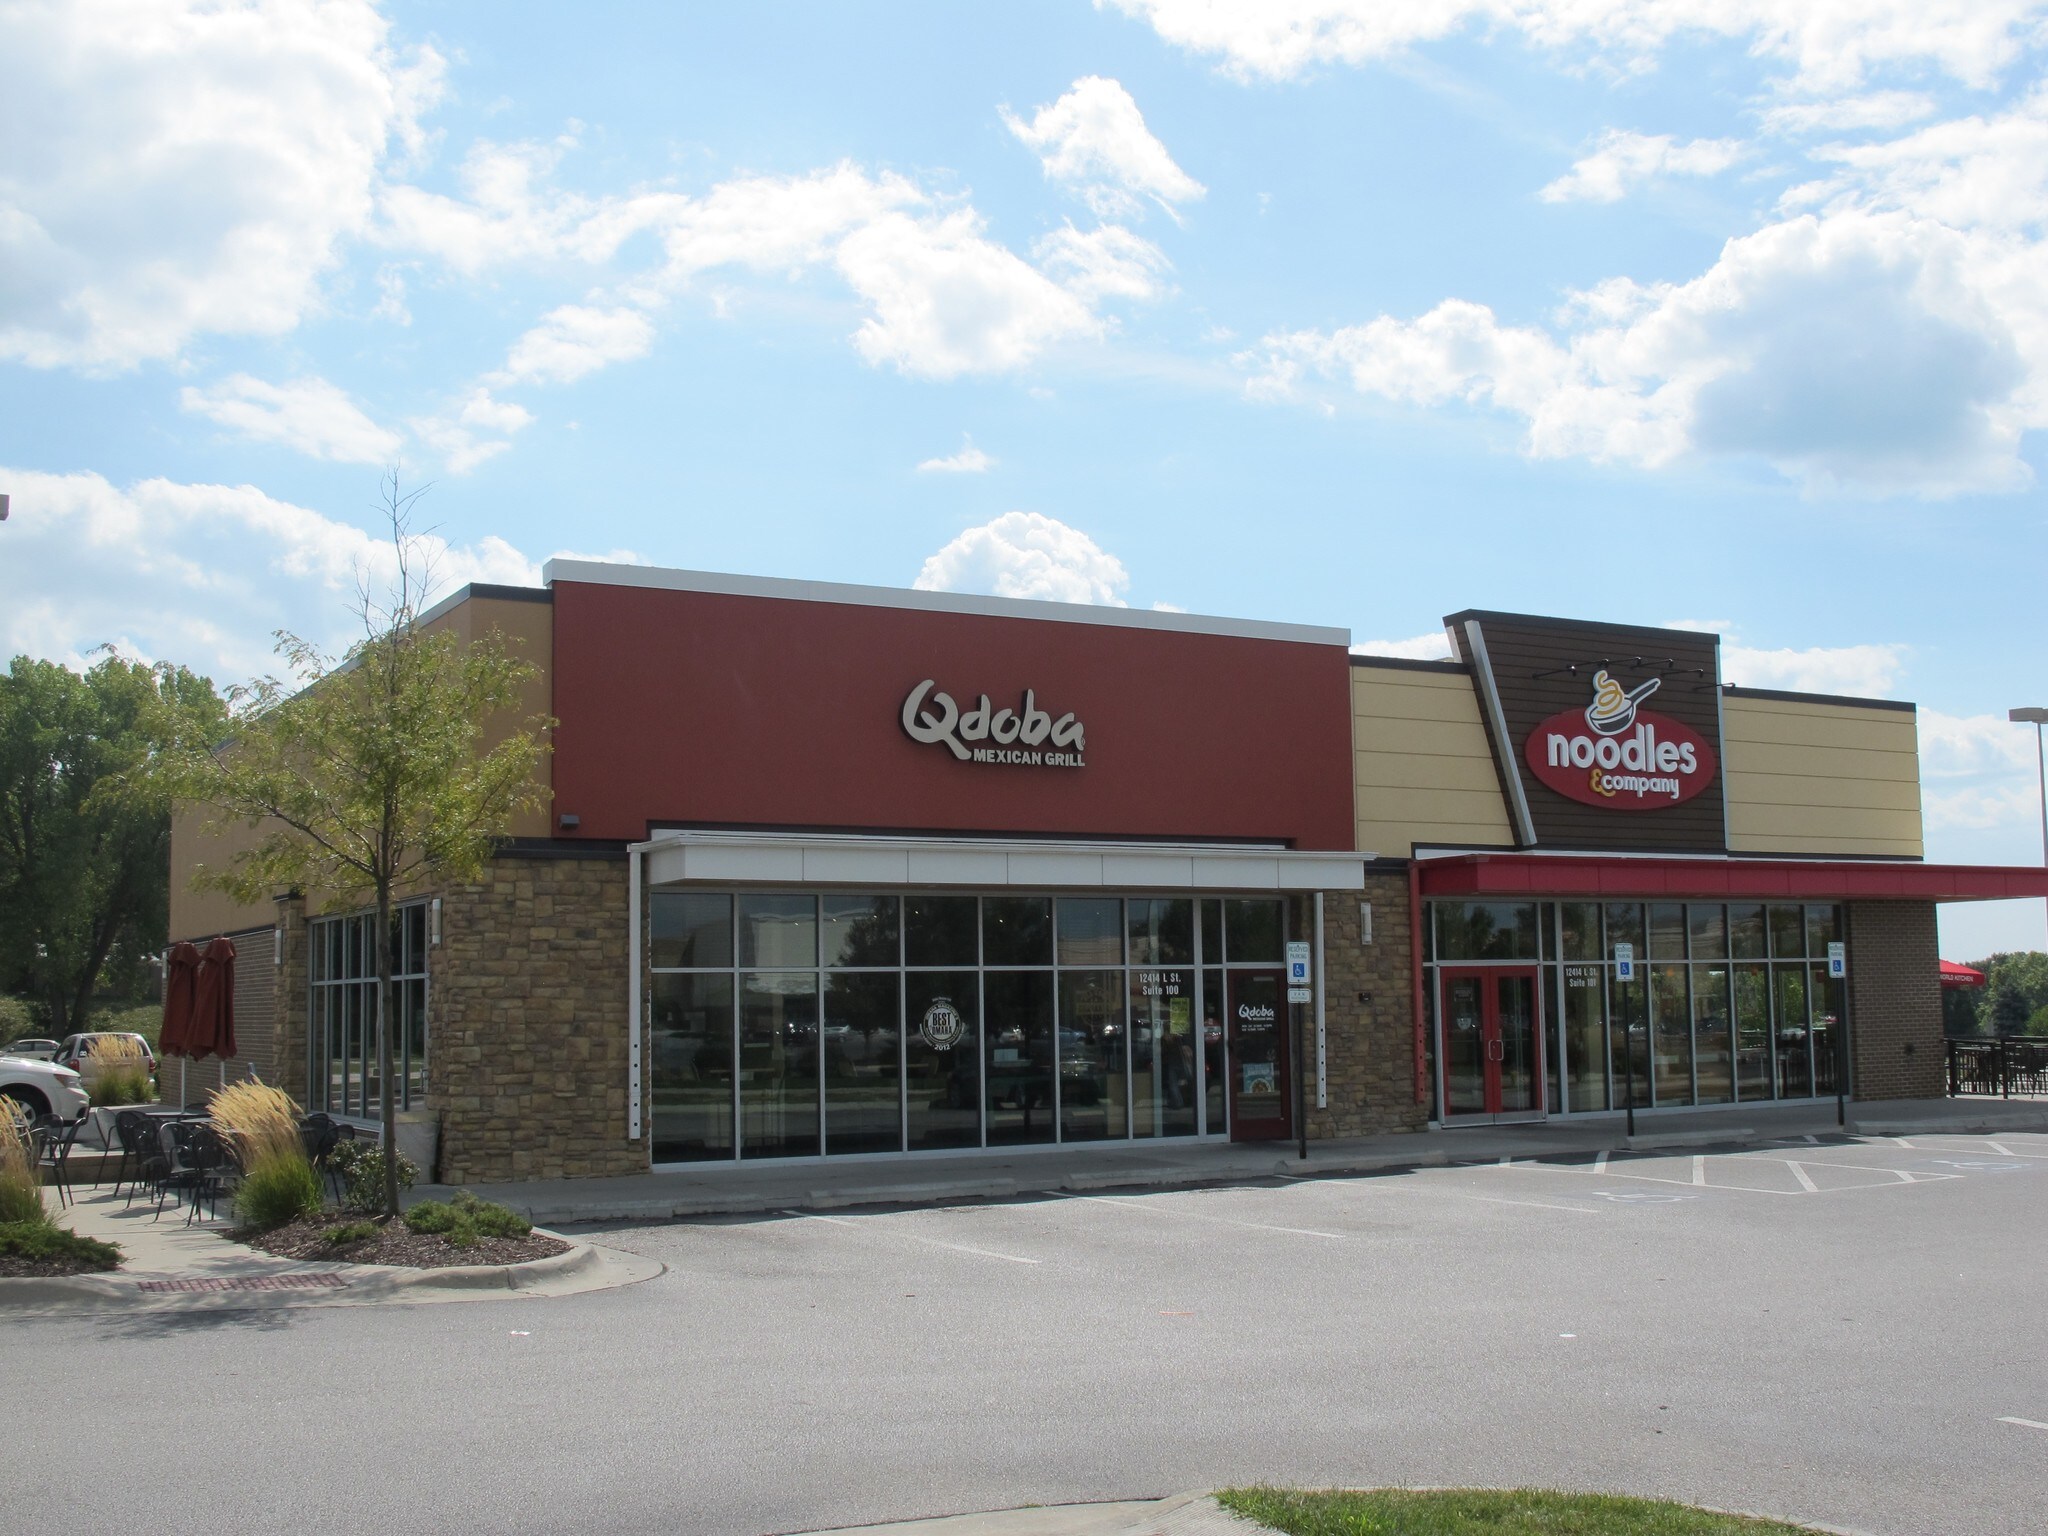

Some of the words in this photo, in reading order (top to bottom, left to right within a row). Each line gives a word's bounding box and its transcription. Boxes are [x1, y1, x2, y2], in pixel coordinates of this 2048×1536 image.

[902, 679, 1084, 760] Qdoba
[1547, 723, 1697, 774] noodles
[974, 749, 1042, 765] MEXICAN
[1045, 753, 1086, 767] GRILL
[1139, 973, 1160, 983] 12414
[1163, 972, 1168, 983] L
[1170, 972, 1182, 983] St.
[1565, 967, 1582, 977] 12414
[1583, 968, 1588, 976] L
[1569, 978, 1585, 988] Suite
[1142, 985, 1163, 996] Suite
[1165, 985, 1179, 995] 100
[932, 1012, 951, 1026] BEST
[1238, 1003, 1274, 1021] Qdoba
